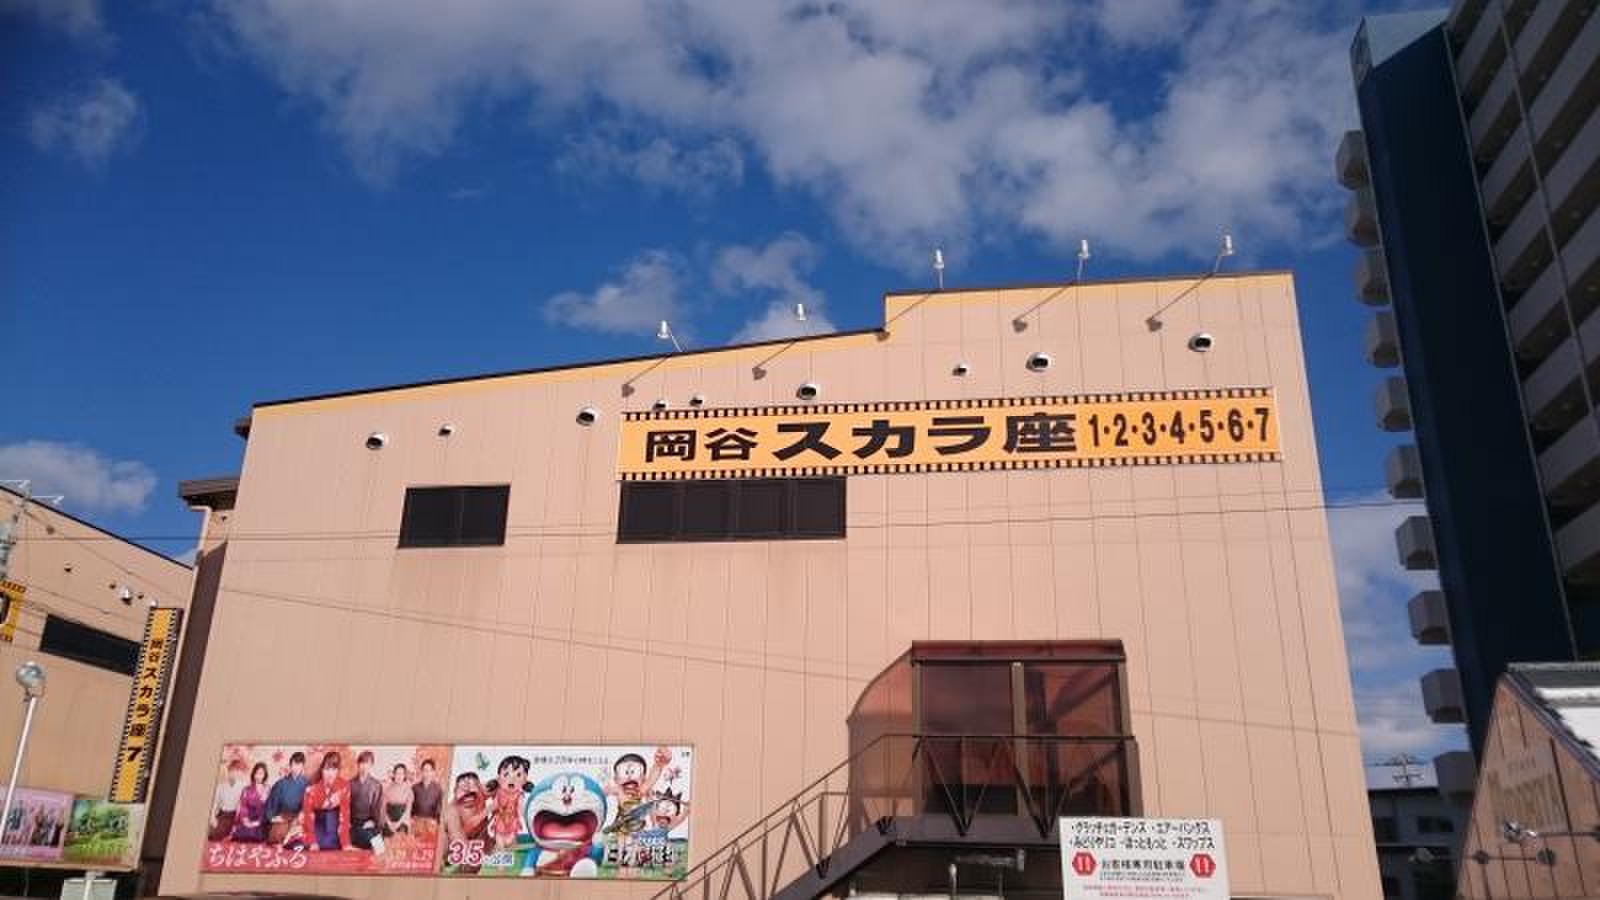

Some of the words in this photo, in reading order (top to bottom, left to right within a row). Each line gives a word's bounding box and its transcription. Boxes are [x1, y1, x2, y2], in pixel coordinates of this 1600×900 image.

[644, 411, 1078, 463] 岡谷スカラ座
[130, 638, 163, 737] 岡谷スカラ座
[126, 746, 142, 762] 7
[208, 843, 308, 869] ちはやふる
